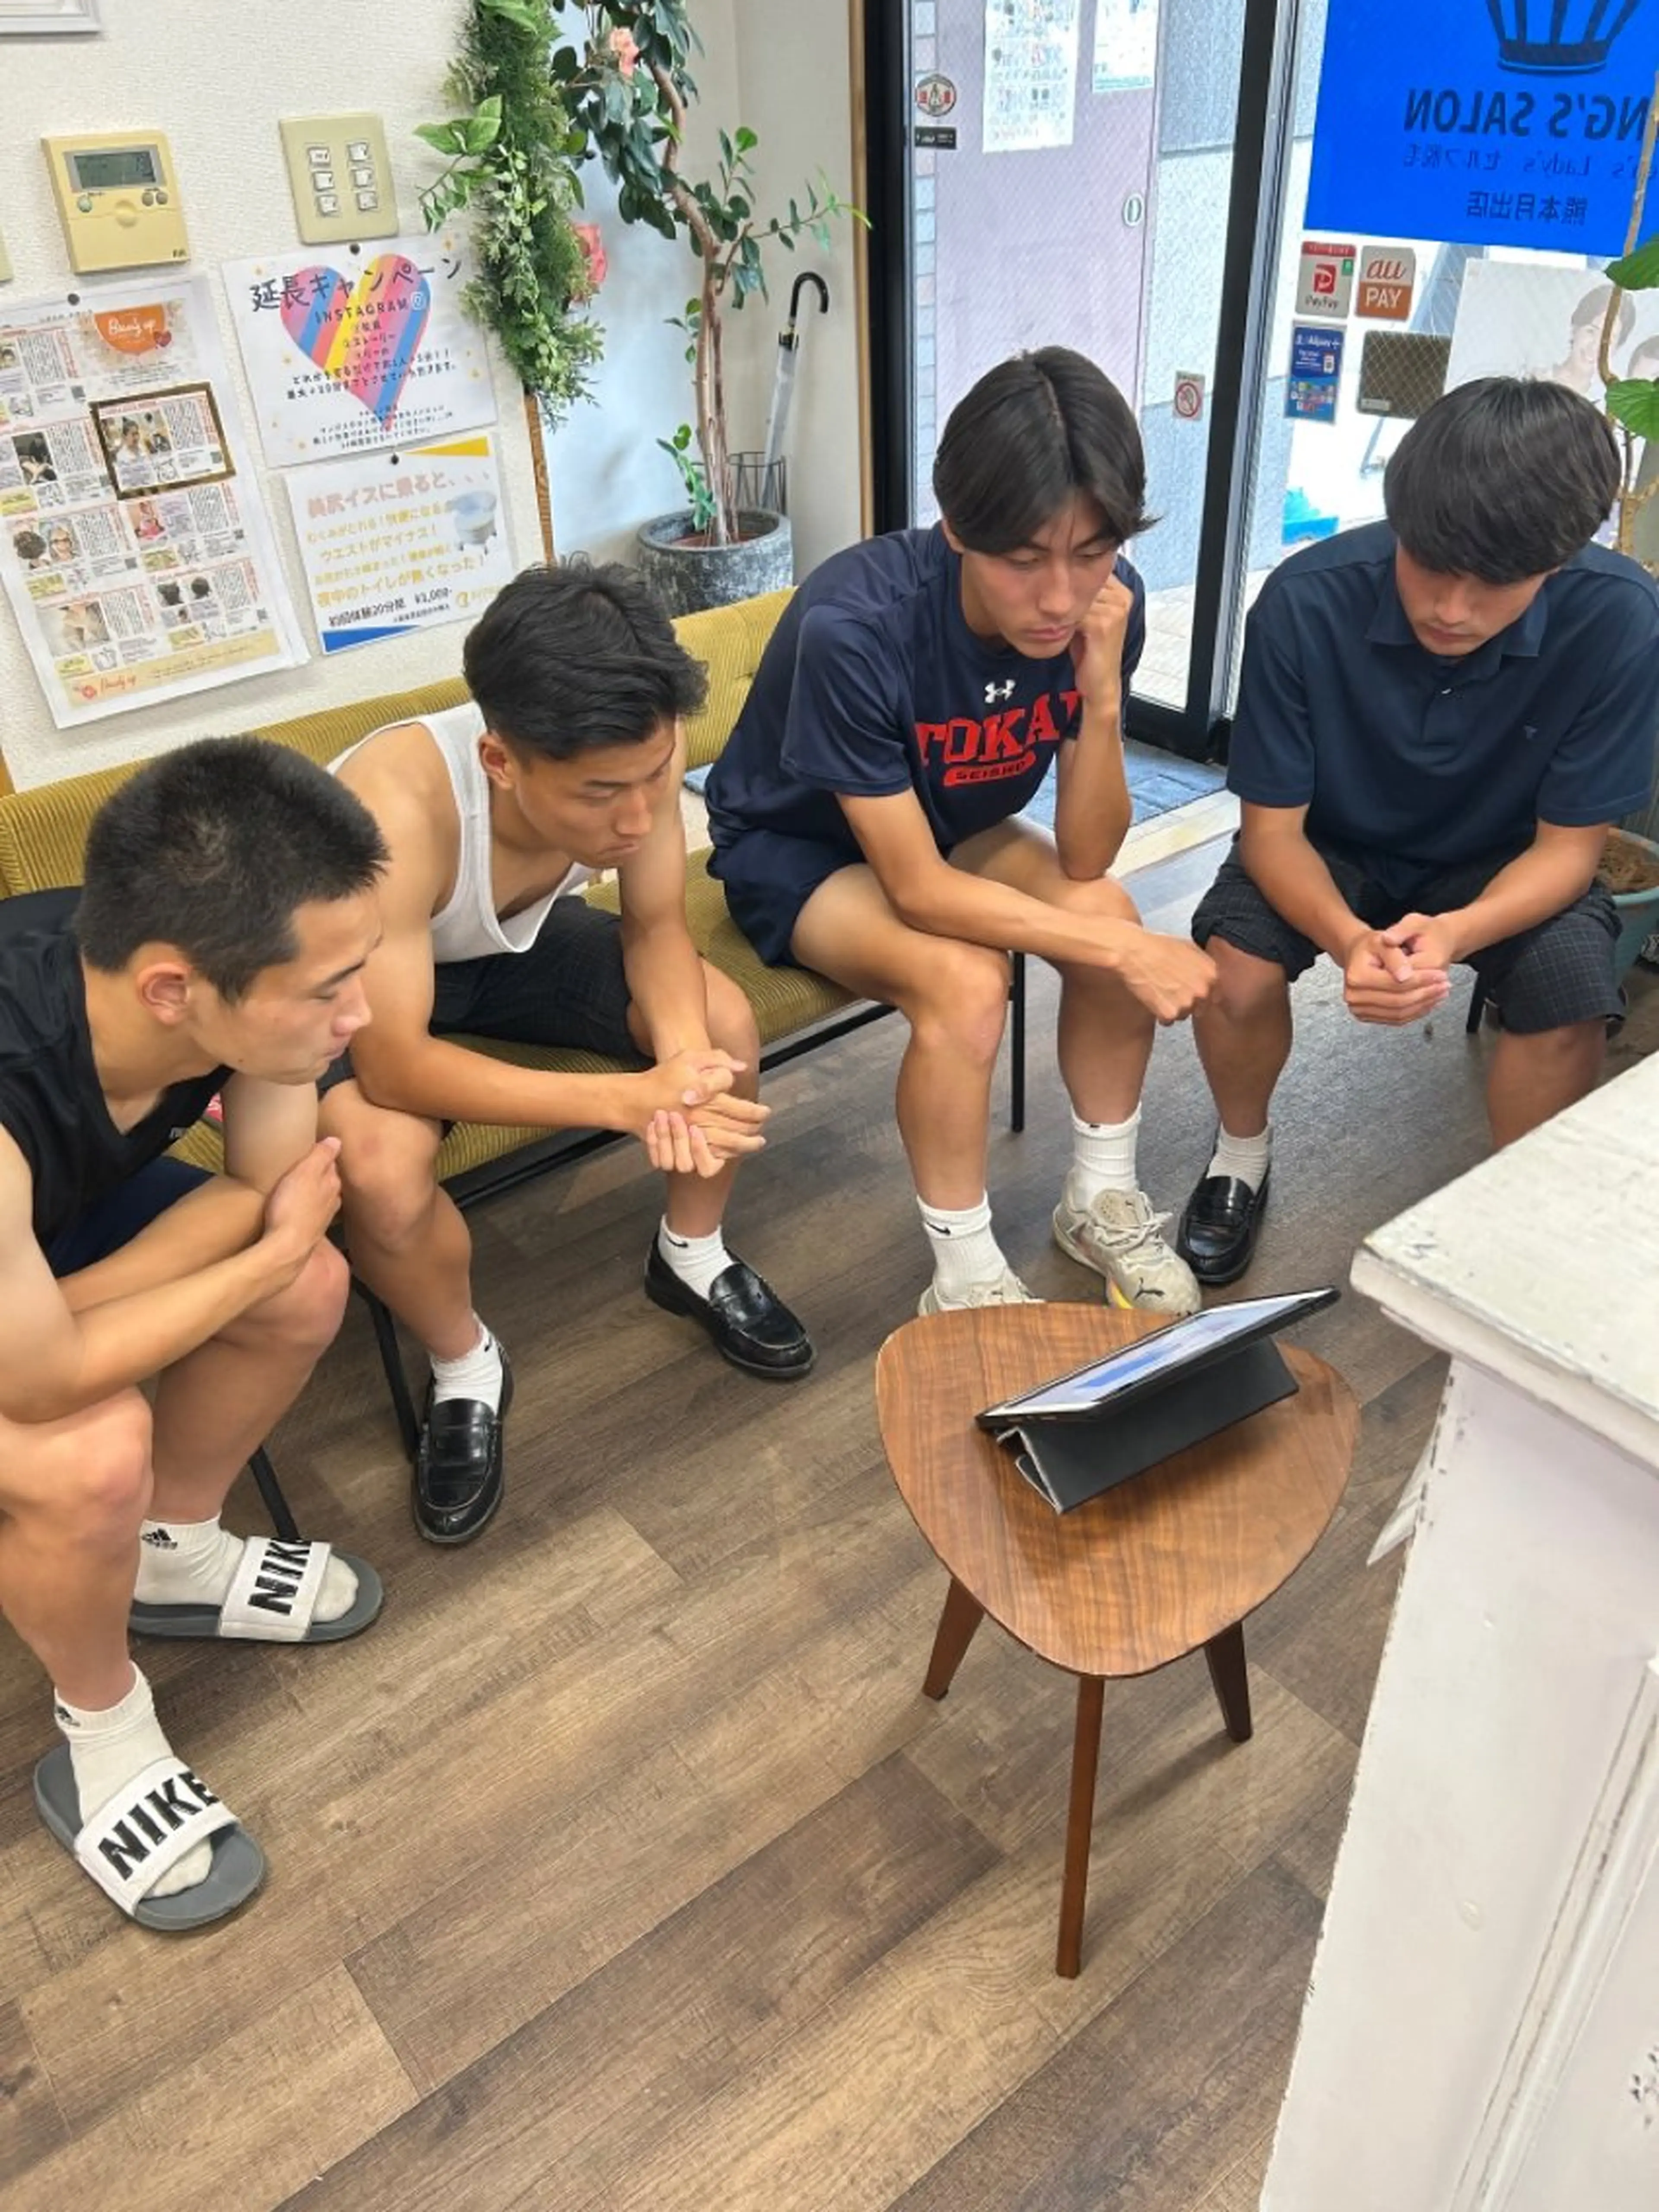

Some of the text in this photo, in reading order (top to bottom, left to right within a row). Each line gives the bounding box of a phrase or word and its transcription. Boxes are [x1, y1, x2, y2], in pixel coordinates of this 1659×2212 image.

[1367, 258, 1406, 281] au
[250, 257, 462, 313] 延長キャンペーン
[1365, 287, 1402, 308] PAY
[315, 297, 408, 324] INSTAGRAM
